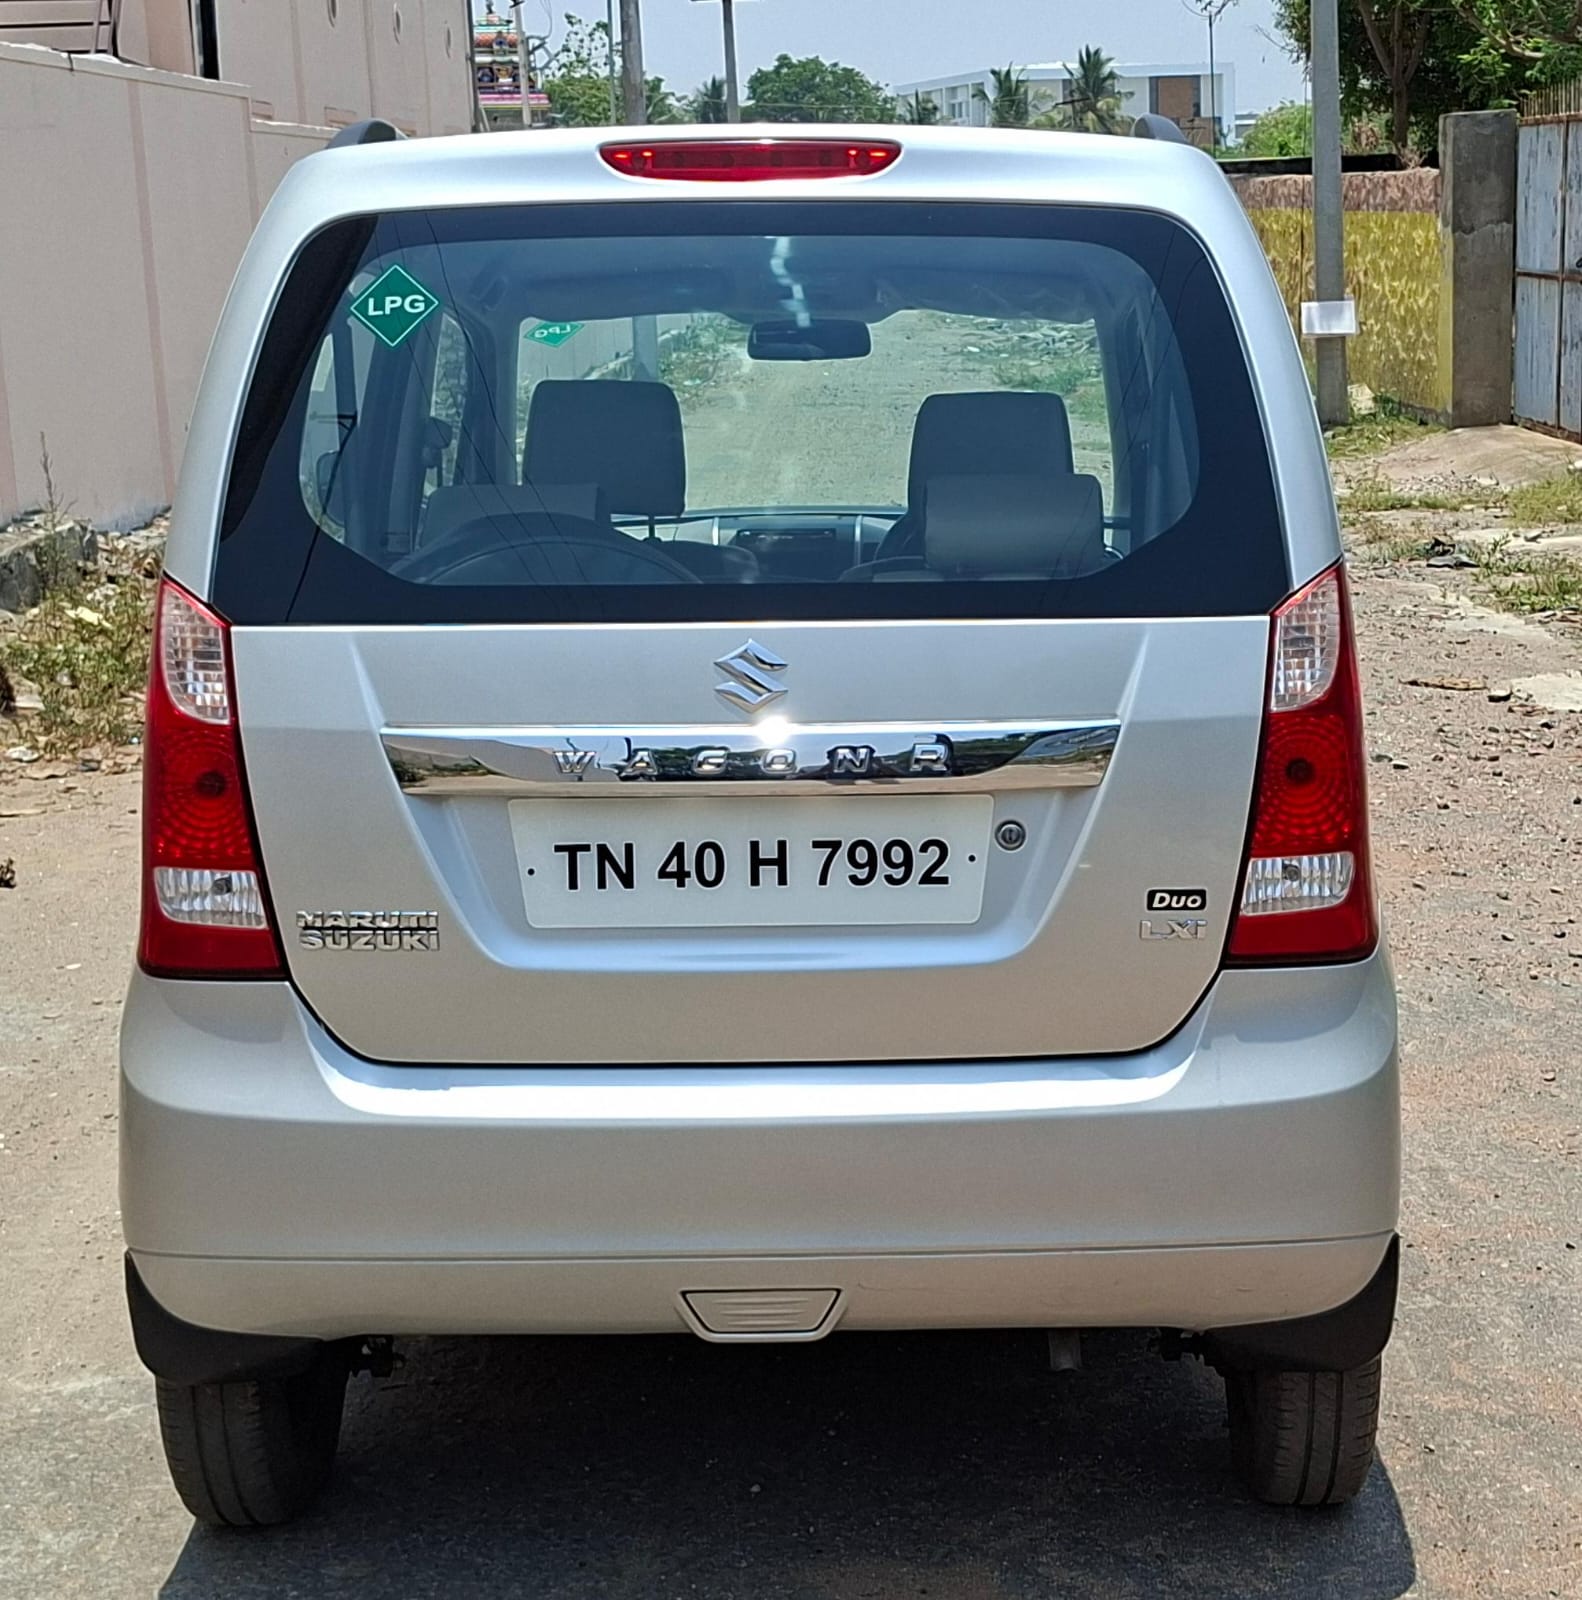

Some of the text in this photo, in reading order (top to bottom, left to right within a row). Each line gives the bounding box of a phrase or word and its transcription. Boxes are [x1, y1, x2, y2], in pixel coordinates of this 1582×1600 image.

[367, 294, 426, 316] LPG
[554, 839, 950, 890] TN 40 H 7992
[297, 910, 438, 929] MARUTI
[300, 929, 440, 951] SUZUKI
